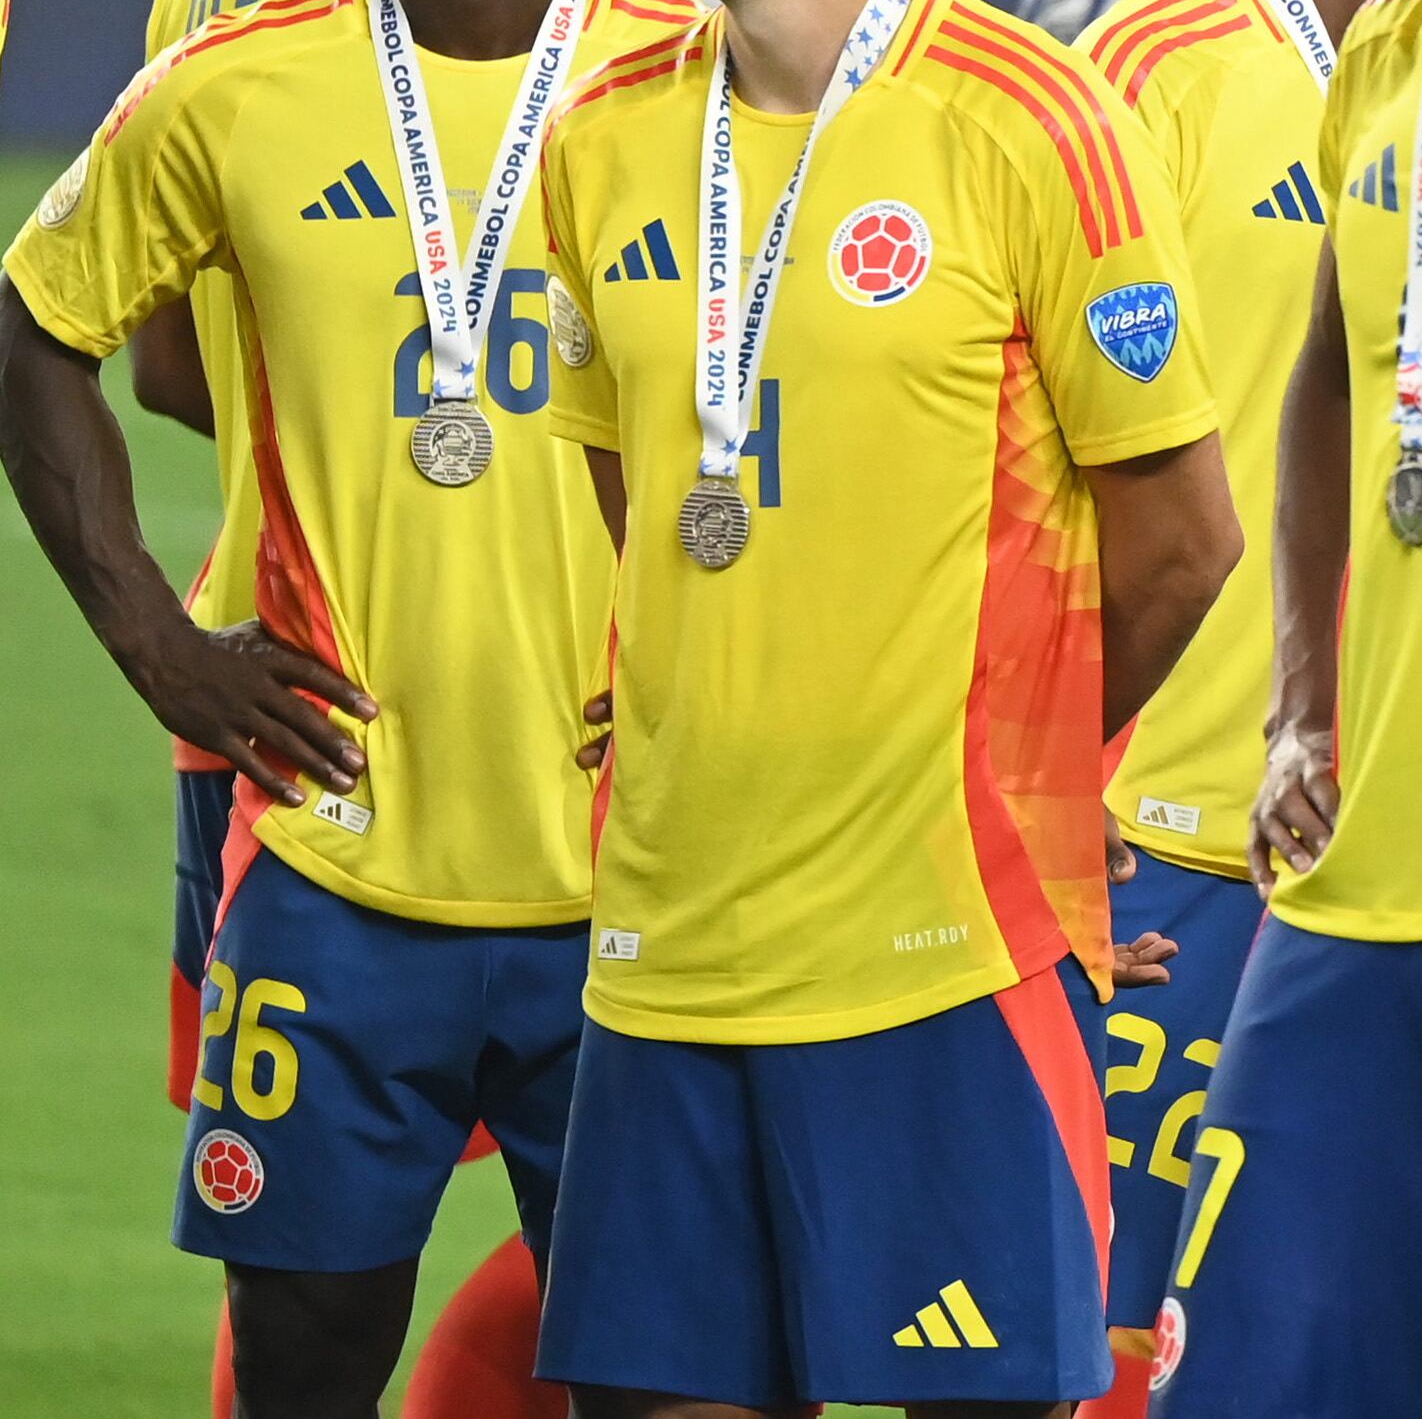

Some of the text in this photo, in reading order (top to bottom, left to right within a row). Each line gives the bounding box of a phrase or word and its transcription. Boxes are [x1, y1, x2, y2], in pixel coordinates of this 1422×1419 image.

[391, 65, 418, 124] COPA
[497, 142, 531, 198] COPA
[518, 46, 562, 138] AMERICA
[551, 6, 573, 42] USA
[404, 128, 438, 226] AMERICA
[712, 116, 731, 178] COPA
[425, 230, 447, 275] USA
[709, 183, 727, 292] AMERICA
[765, 199, 792, 263] COPA
[434, 279, 456, 332] 2024
[707, 298, 726, 344] USA
[1102, 302, 1166, 334] VIBRA
[707, 350, 725, 407] 2024
[192, 960, 307, 1121] 26
